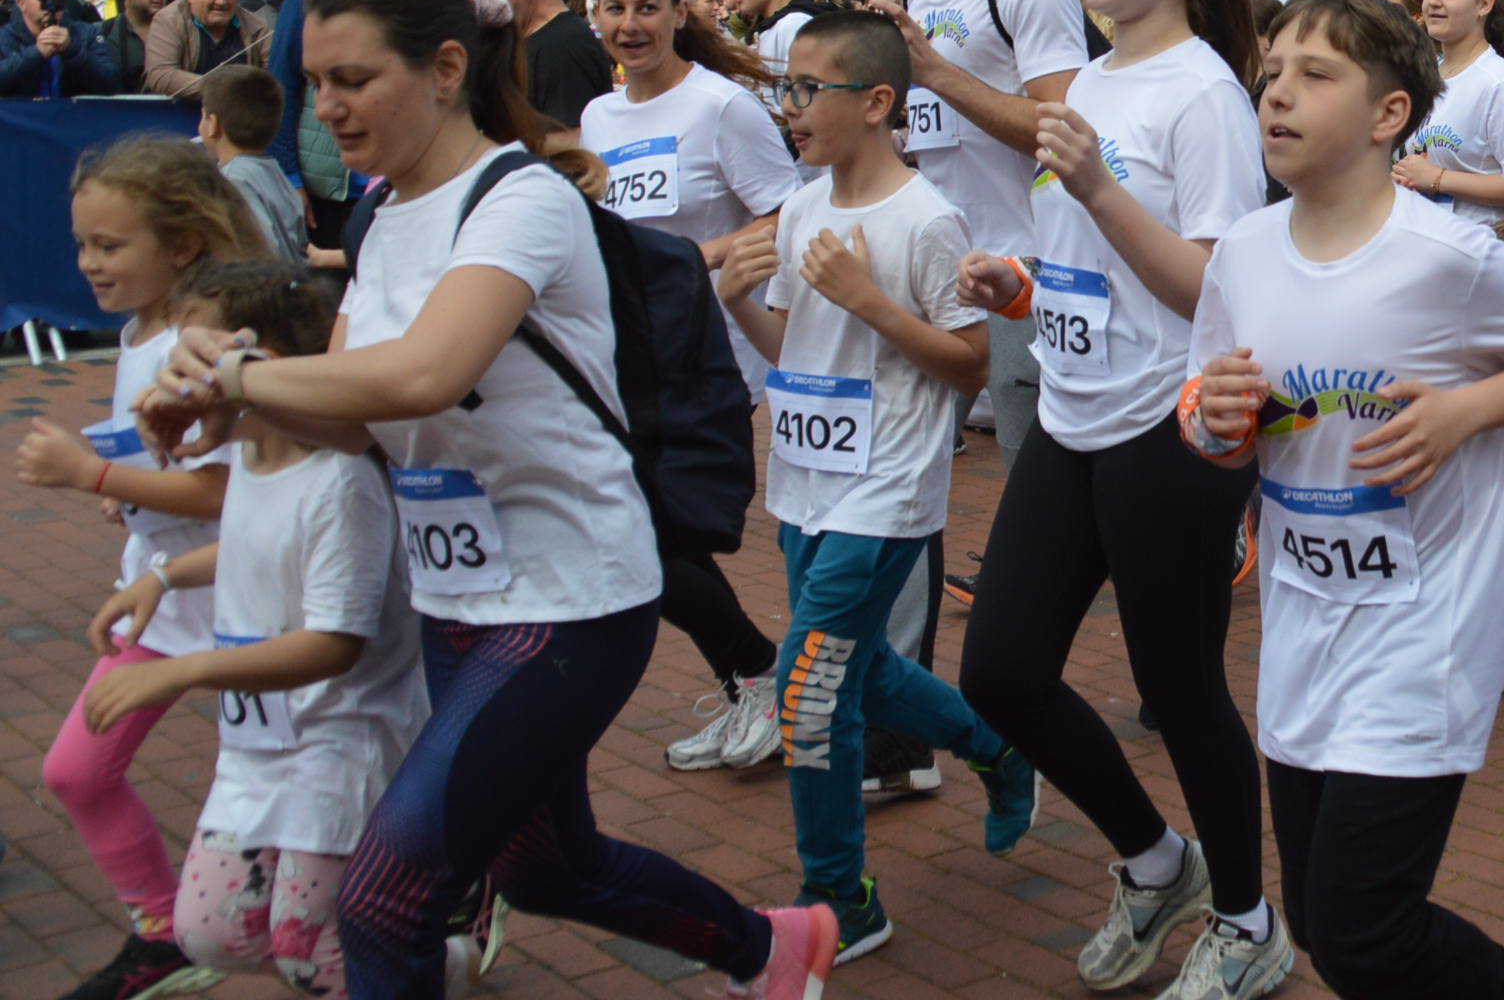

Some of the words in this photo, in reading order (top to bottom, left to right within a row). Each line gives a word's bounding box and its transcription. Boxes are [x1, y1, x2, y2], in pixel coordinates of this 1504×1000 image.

[925, 8, 970, 40] Marathon
[907, 101, 942, 135] 751
[1414, 124, 1464, 145] Marathon
[1097, 135, 1130, 183] athon
[605, 170, 668, 209] 4752
[1282, 363, 1409, 408] Marat
[776, 409, 857, 453] 4102
[1292, 490, 1353, 503] DECATHLON
[1281, 526, 1398, 580] 4514
[781, 629, 857, 771] BRONX
